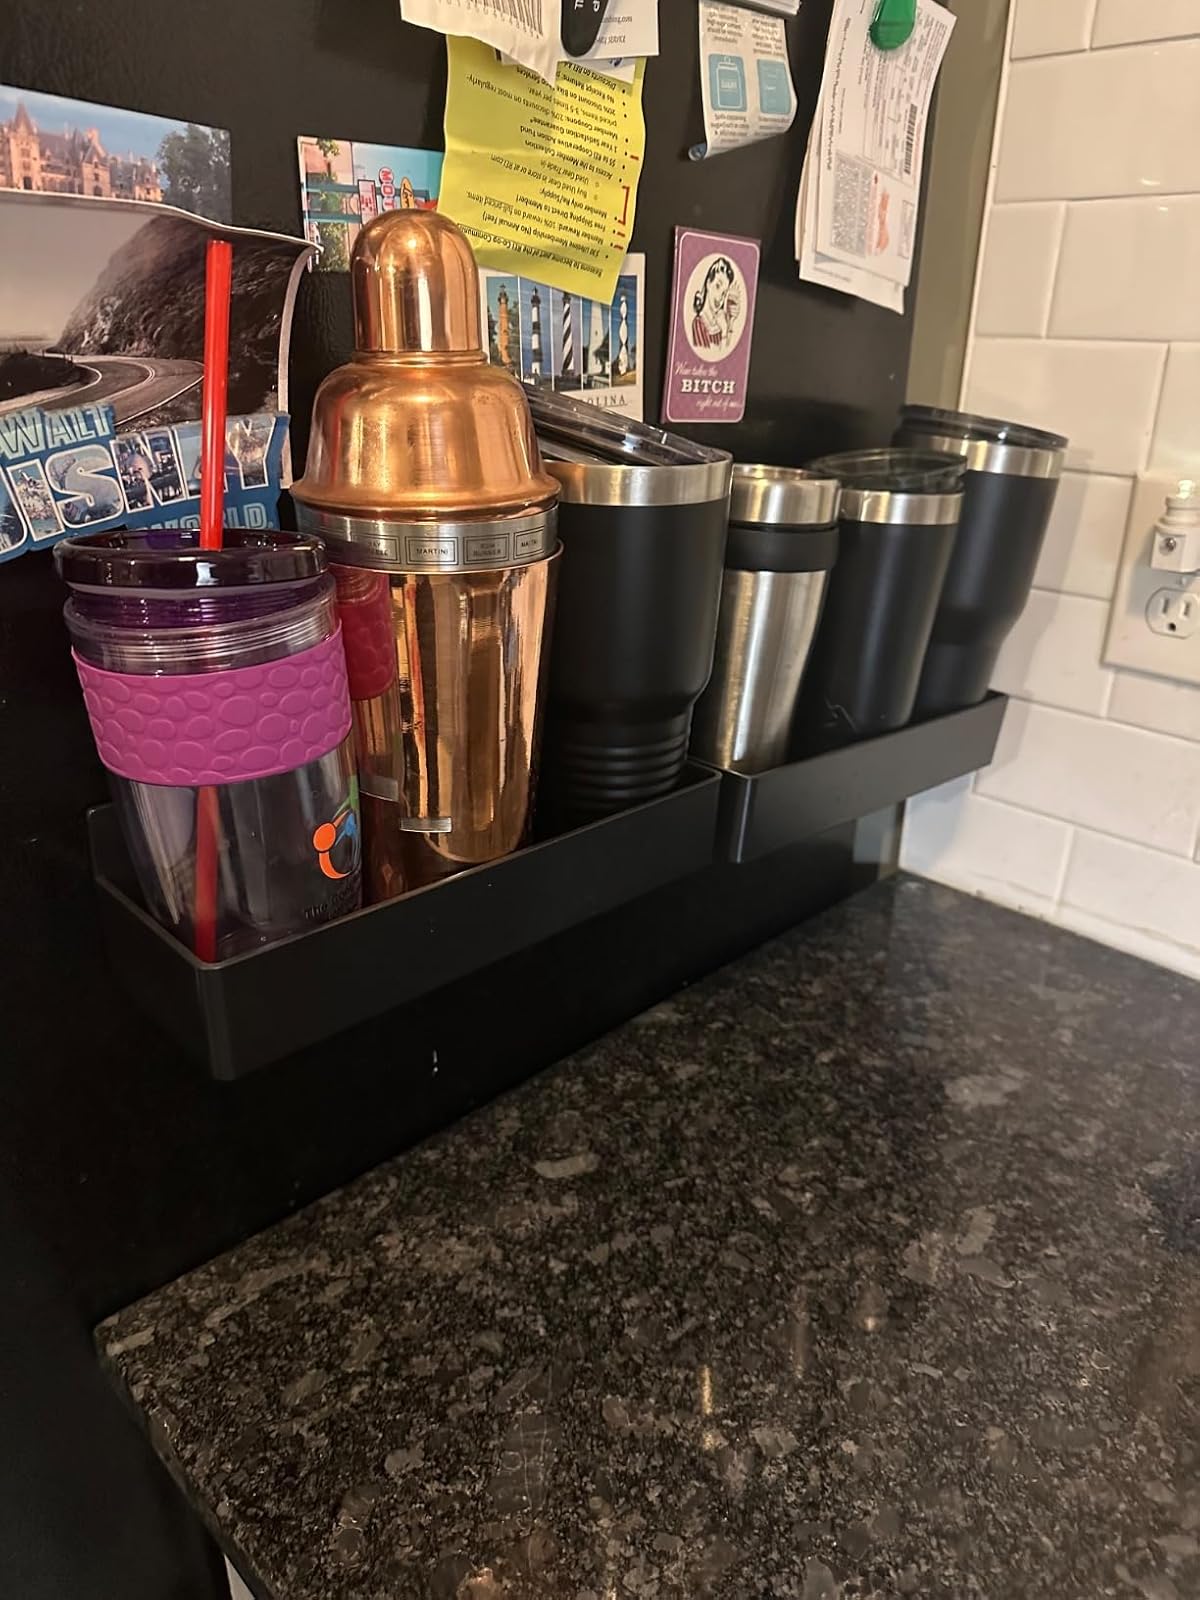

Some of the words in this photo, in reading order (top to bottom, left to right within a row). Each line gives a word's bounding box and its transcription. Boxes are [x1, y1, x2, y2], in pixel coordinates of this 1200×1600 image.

[516, 66, 540, 84] Services
[573, 64, 583, 74] REI
[583, 69, 590, 77] on
[591, 72, 616, 91] Discounts
[498, 87, 512, 99] most
[528, 87, 542, 98] year.
[557, 86, 569, 98] Bike
[569, 91, 578, 100] on
[586, 84, 605, 100] Receipt
[513, 95, 521, 104] on
[543, 94, 552, 103] per
[553, 98, 569, 110] times
[579, 95, 603, 111] Discount
[606, 94, 615, 104] No
[522, 98, 550, 116] discounts
[600, 117, 617, 127] priced
[520, 125, 536, 137] Fund
[594, 126, 618, 140] Member
[536, 131, 556, 144] Action
[566, 129, 600, 146] Satisfaction
[525, 140, 555, 157] Collection
[558, 140, 593, 157] Cooperative
[600, 141, 612, 152] Year
[490, 154, 513, 170] REI.com
[556, 152, 579, 166] Member
[593, 152, 602, 160] REI
[520, 166, 527, 174] or
[547, 163, 562, 174] Trade
[580, 160, 588, 170] the
[528, 169, 542, 180] store
[562, 169, 574, 179] Gear
[575, 174, 589, 185] Used
[595, 167, 612, 180] Access
[548, 178, 561, 189] Gear
[562, 183, 576, 194] Used
[576, 187, 587, 199] Buy
[571, 198, 584, 210] only
[522, 211, 543, 224] reward
[552, 207, 569, 219] Direct
[584, 205, 607, 219] Member
[499, 218, 519, 232] Annual
[570, 212, 593, 228] Shipping
[520, 226, 531, 236] (No
[595, 223, 606, 232] Free
[493, 236, 510, 248] Co-op
[533, 228, 568, 248] Membership
[581, 232, 603, 245] Member
[512, 244, 521, 253] REI
[522, 246, 532, 256] the
[540, 251, 552, 260] part
[552, 255, 573, 268] become
[580, 264, 602, 278] Reasons
[681, 379, 735, 394] BITCH
[0, 404, 112, 459] WALT
